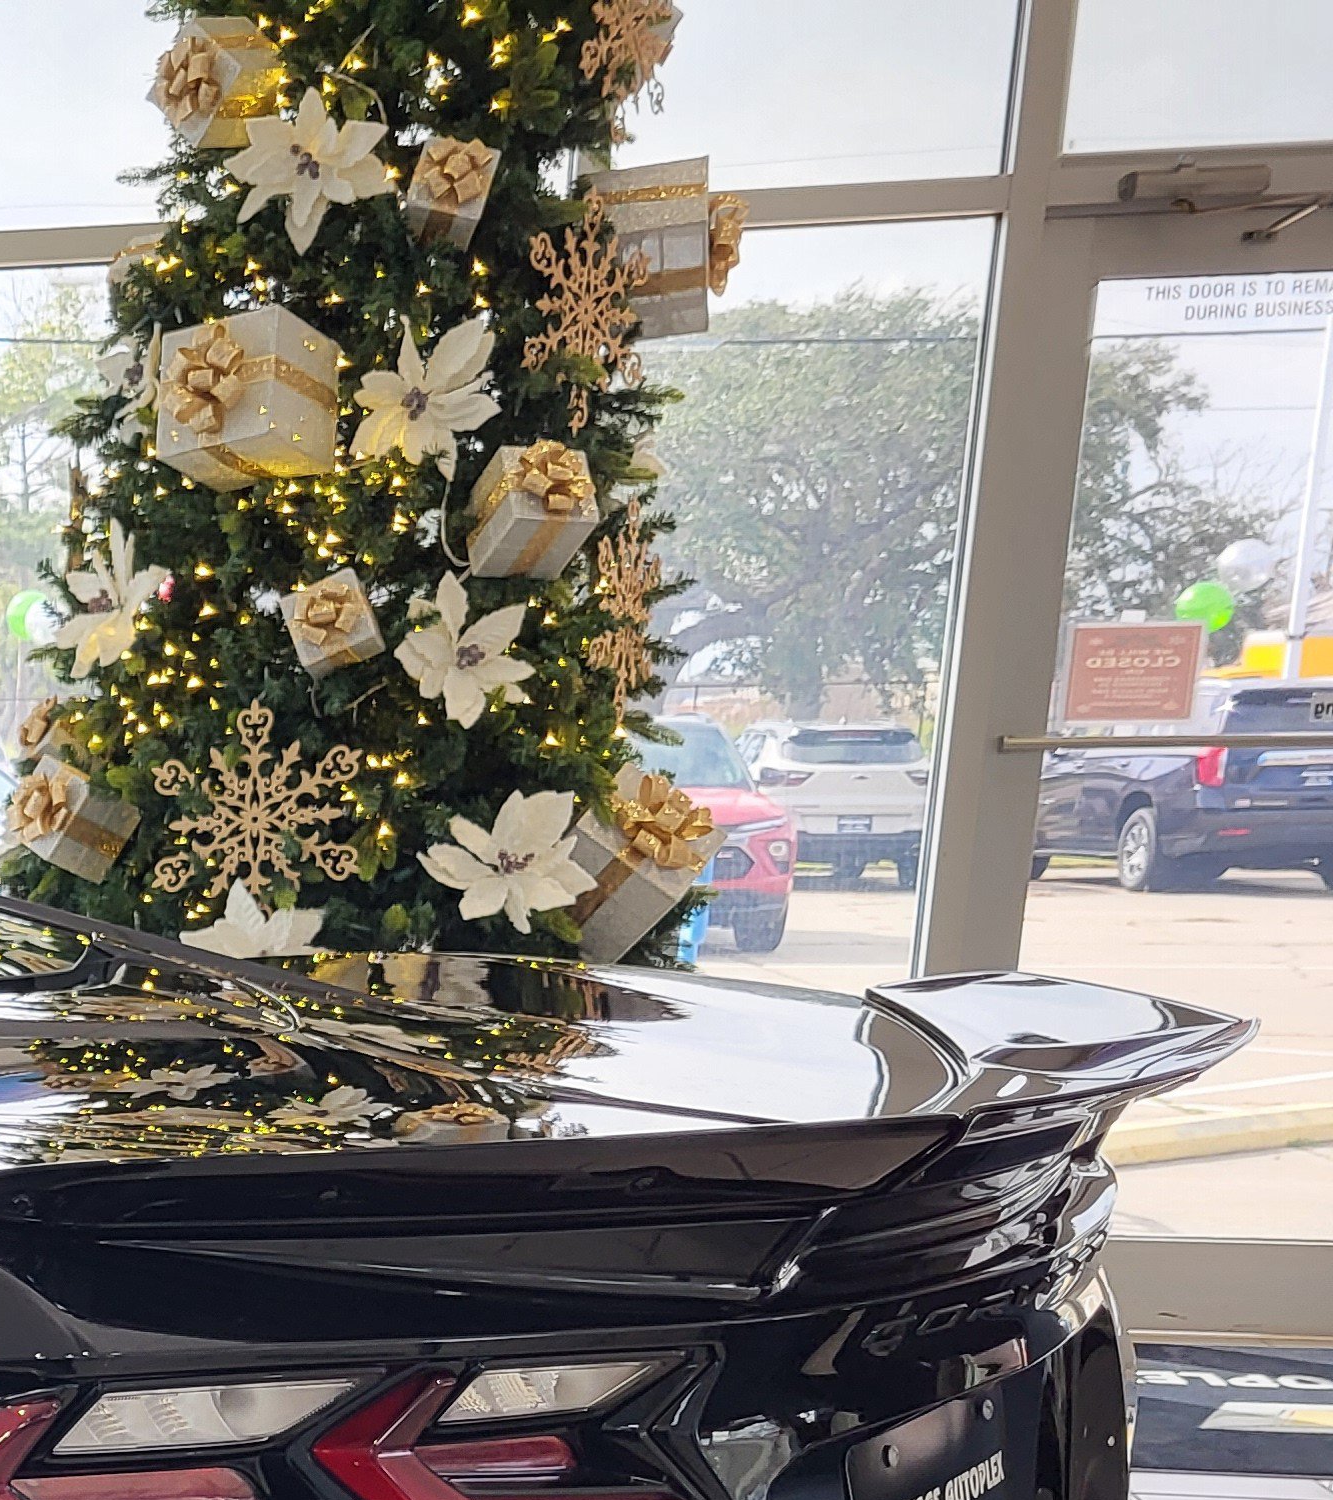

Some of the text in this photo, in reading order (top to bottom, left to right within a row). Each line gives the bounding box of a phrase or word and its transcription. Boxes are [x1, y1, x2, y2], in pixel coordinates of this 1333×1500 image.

[1145, 285, 1182, 301] THIS
[1189, 282, 1235, 300] DOOR
[1242, 280, 1258, 297] IS
[1266, 280, 1285, 296] TO
[1184, 303, 1247, 321] DURING
